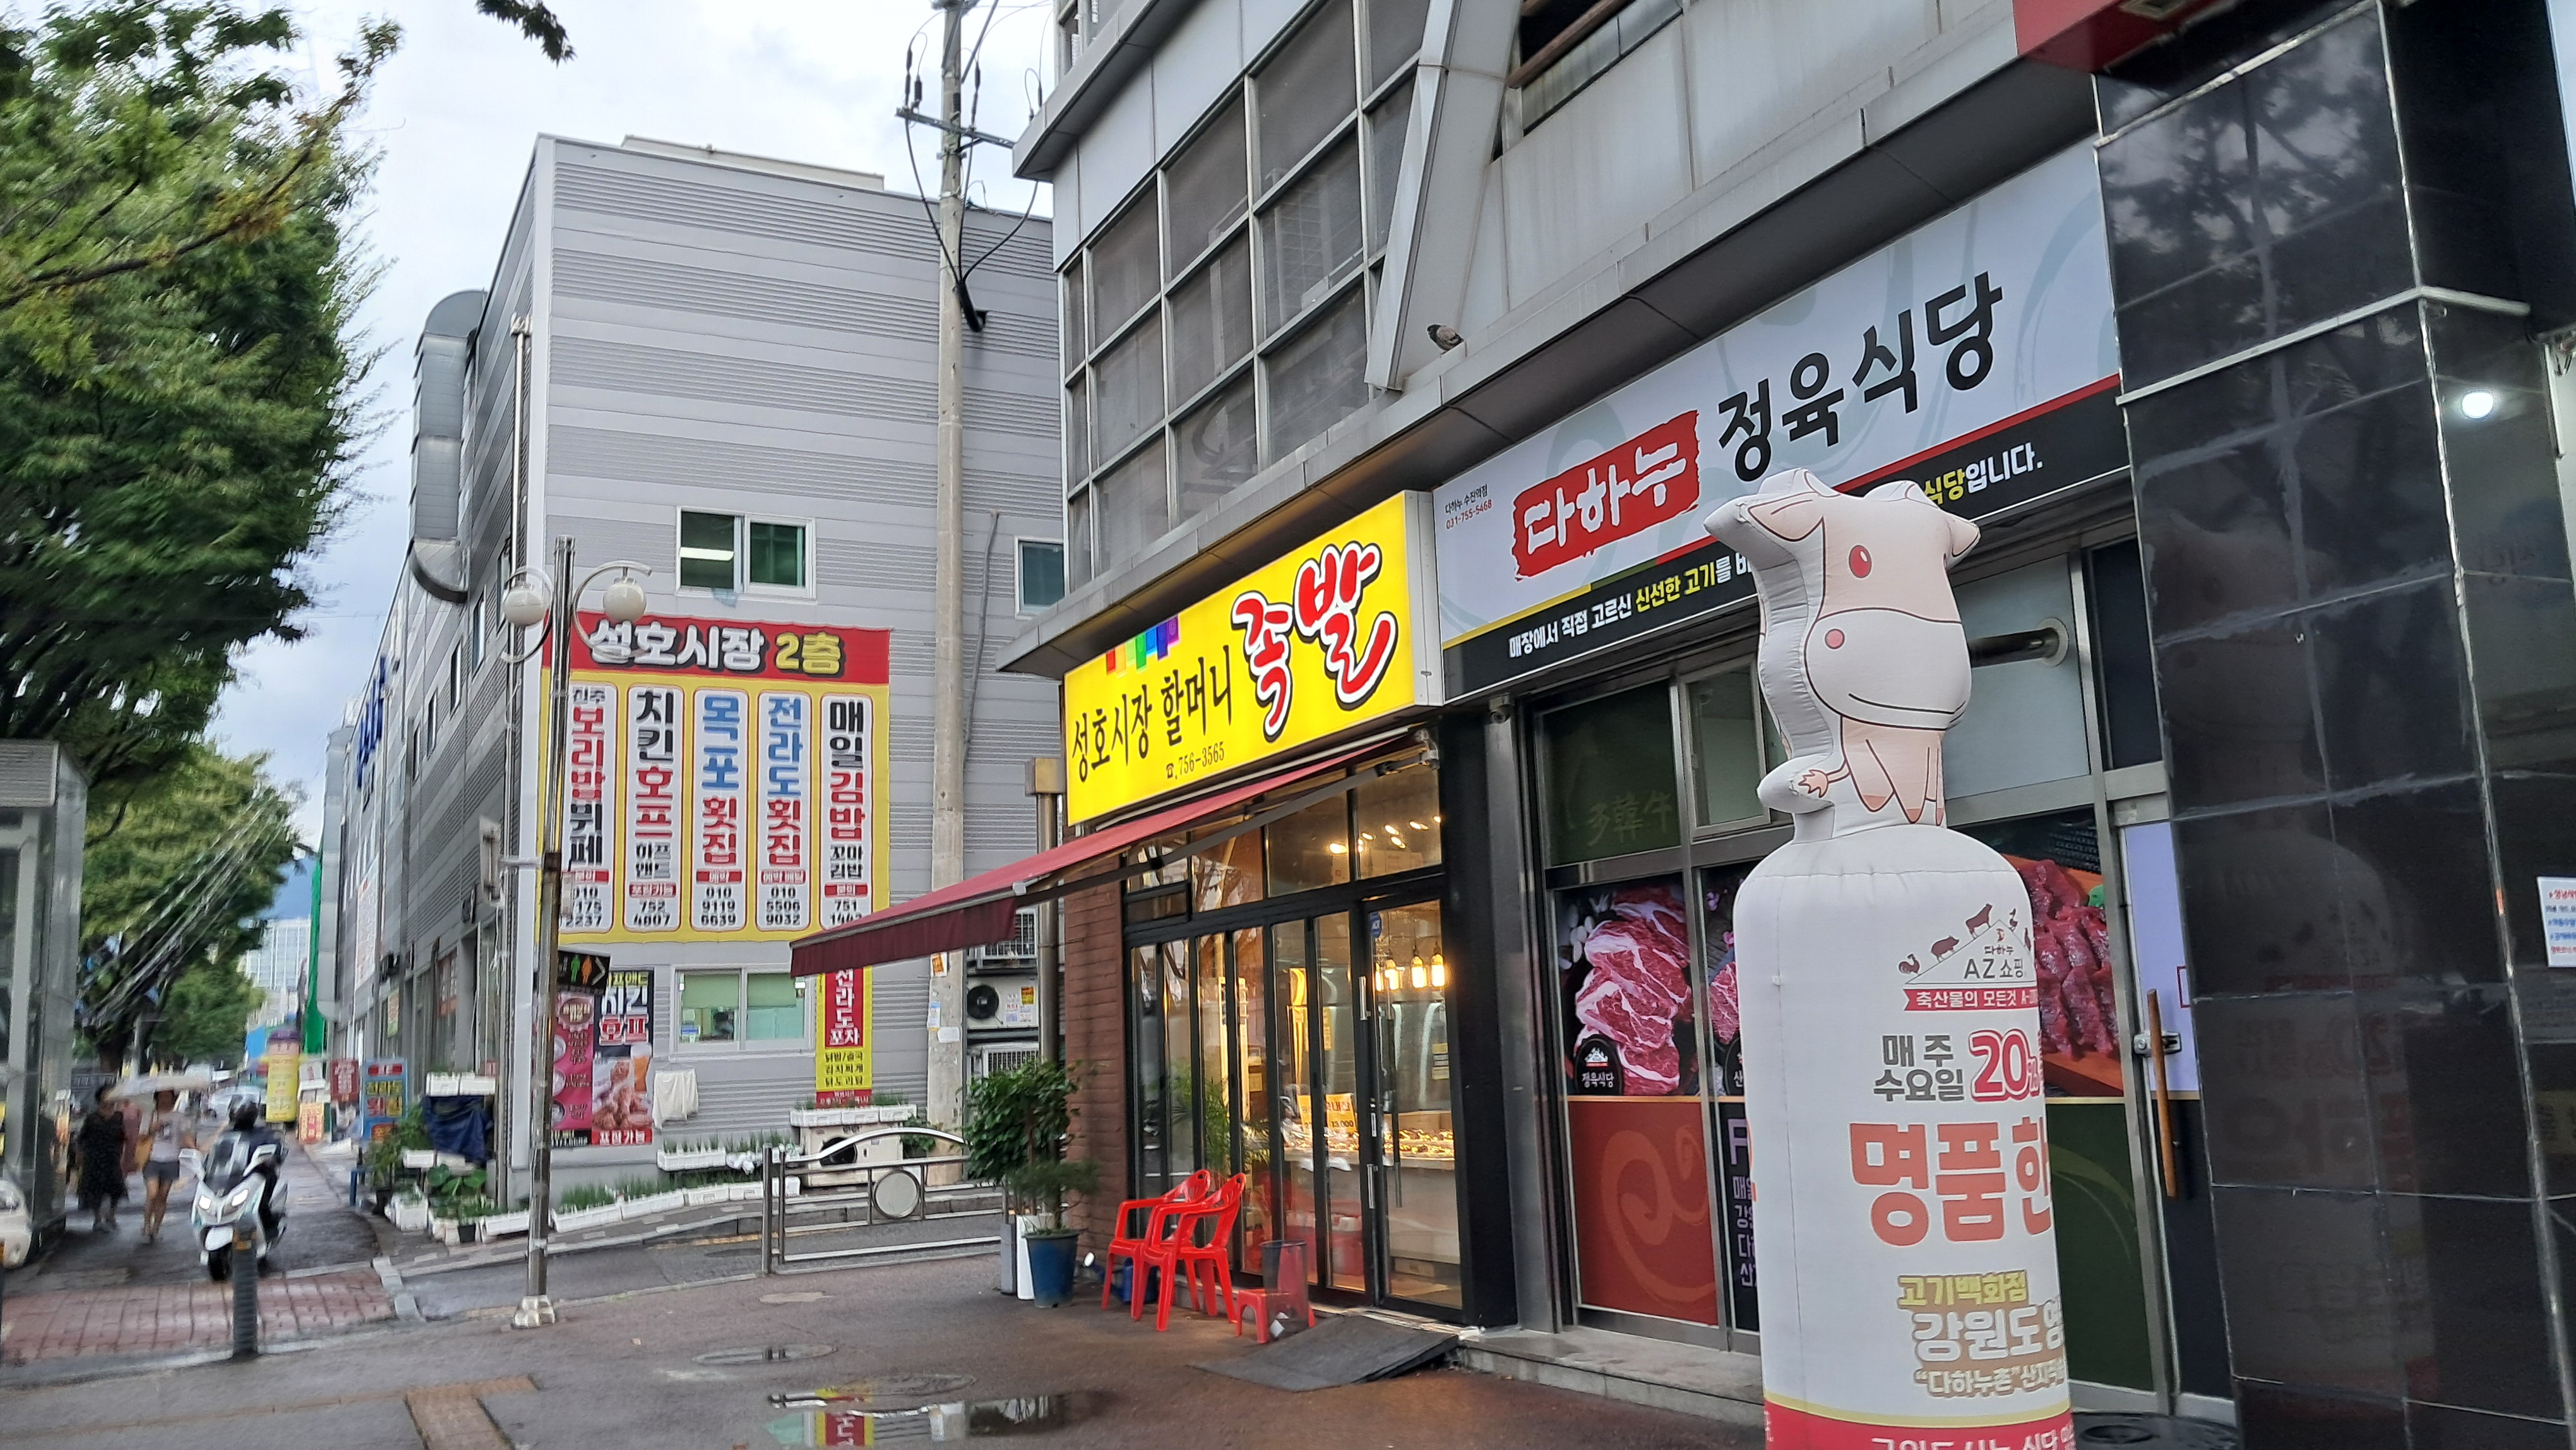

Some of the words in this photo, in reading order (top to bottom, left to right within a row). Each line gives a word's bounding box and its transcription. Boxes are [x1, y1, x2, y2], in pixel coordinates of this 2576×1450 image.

[1718, 271, 2003, 482] 정육식당
[1445, 498, 1462, 514] 다하누
[1464, 483, 1488, 506] 수진역점
[1524, 442, 1687, 555] 다하누
[1446, 499, 1493, 530] 031-755-5468
[1508, 621, 1559, 659] 매장에서
[1561, 609, 1589, 638] 직접
[1590, 593, 1632, 630] 고르신
[1635, 577, 1681, 613] 신선한
[1683, 555, 1732, 596] 고기를
[590, 619, 765, 671] 성호시장
[775, 632, 842, 675] 2층
[1232, 542, 1397, 741] 족발
[1071, 683, 1152, 782] 성호시장
[1160, 645, 1232, 747] 할머니
[701, 899, 736, 913] 9119
[705, 886, 732, 899] 010
[770, 886, 796, 899] 010
[765, 913, 801, 926] 9032
[1983, 944, 2014, 956] 다하누
[1964, 958, 1996, 979] AZ
[1999, 957, 2024, 978] 쇼핑
[1916, 990, 1979, 1008] 축산물의
[1983, 990, 2017, 1007] 모든것
[1581, 1070, 1615, 1088] 정육식당
[1873, 1069, 1965, 1102] 수요일
[1898, 1271, 2027, 1306] 고기백화점
